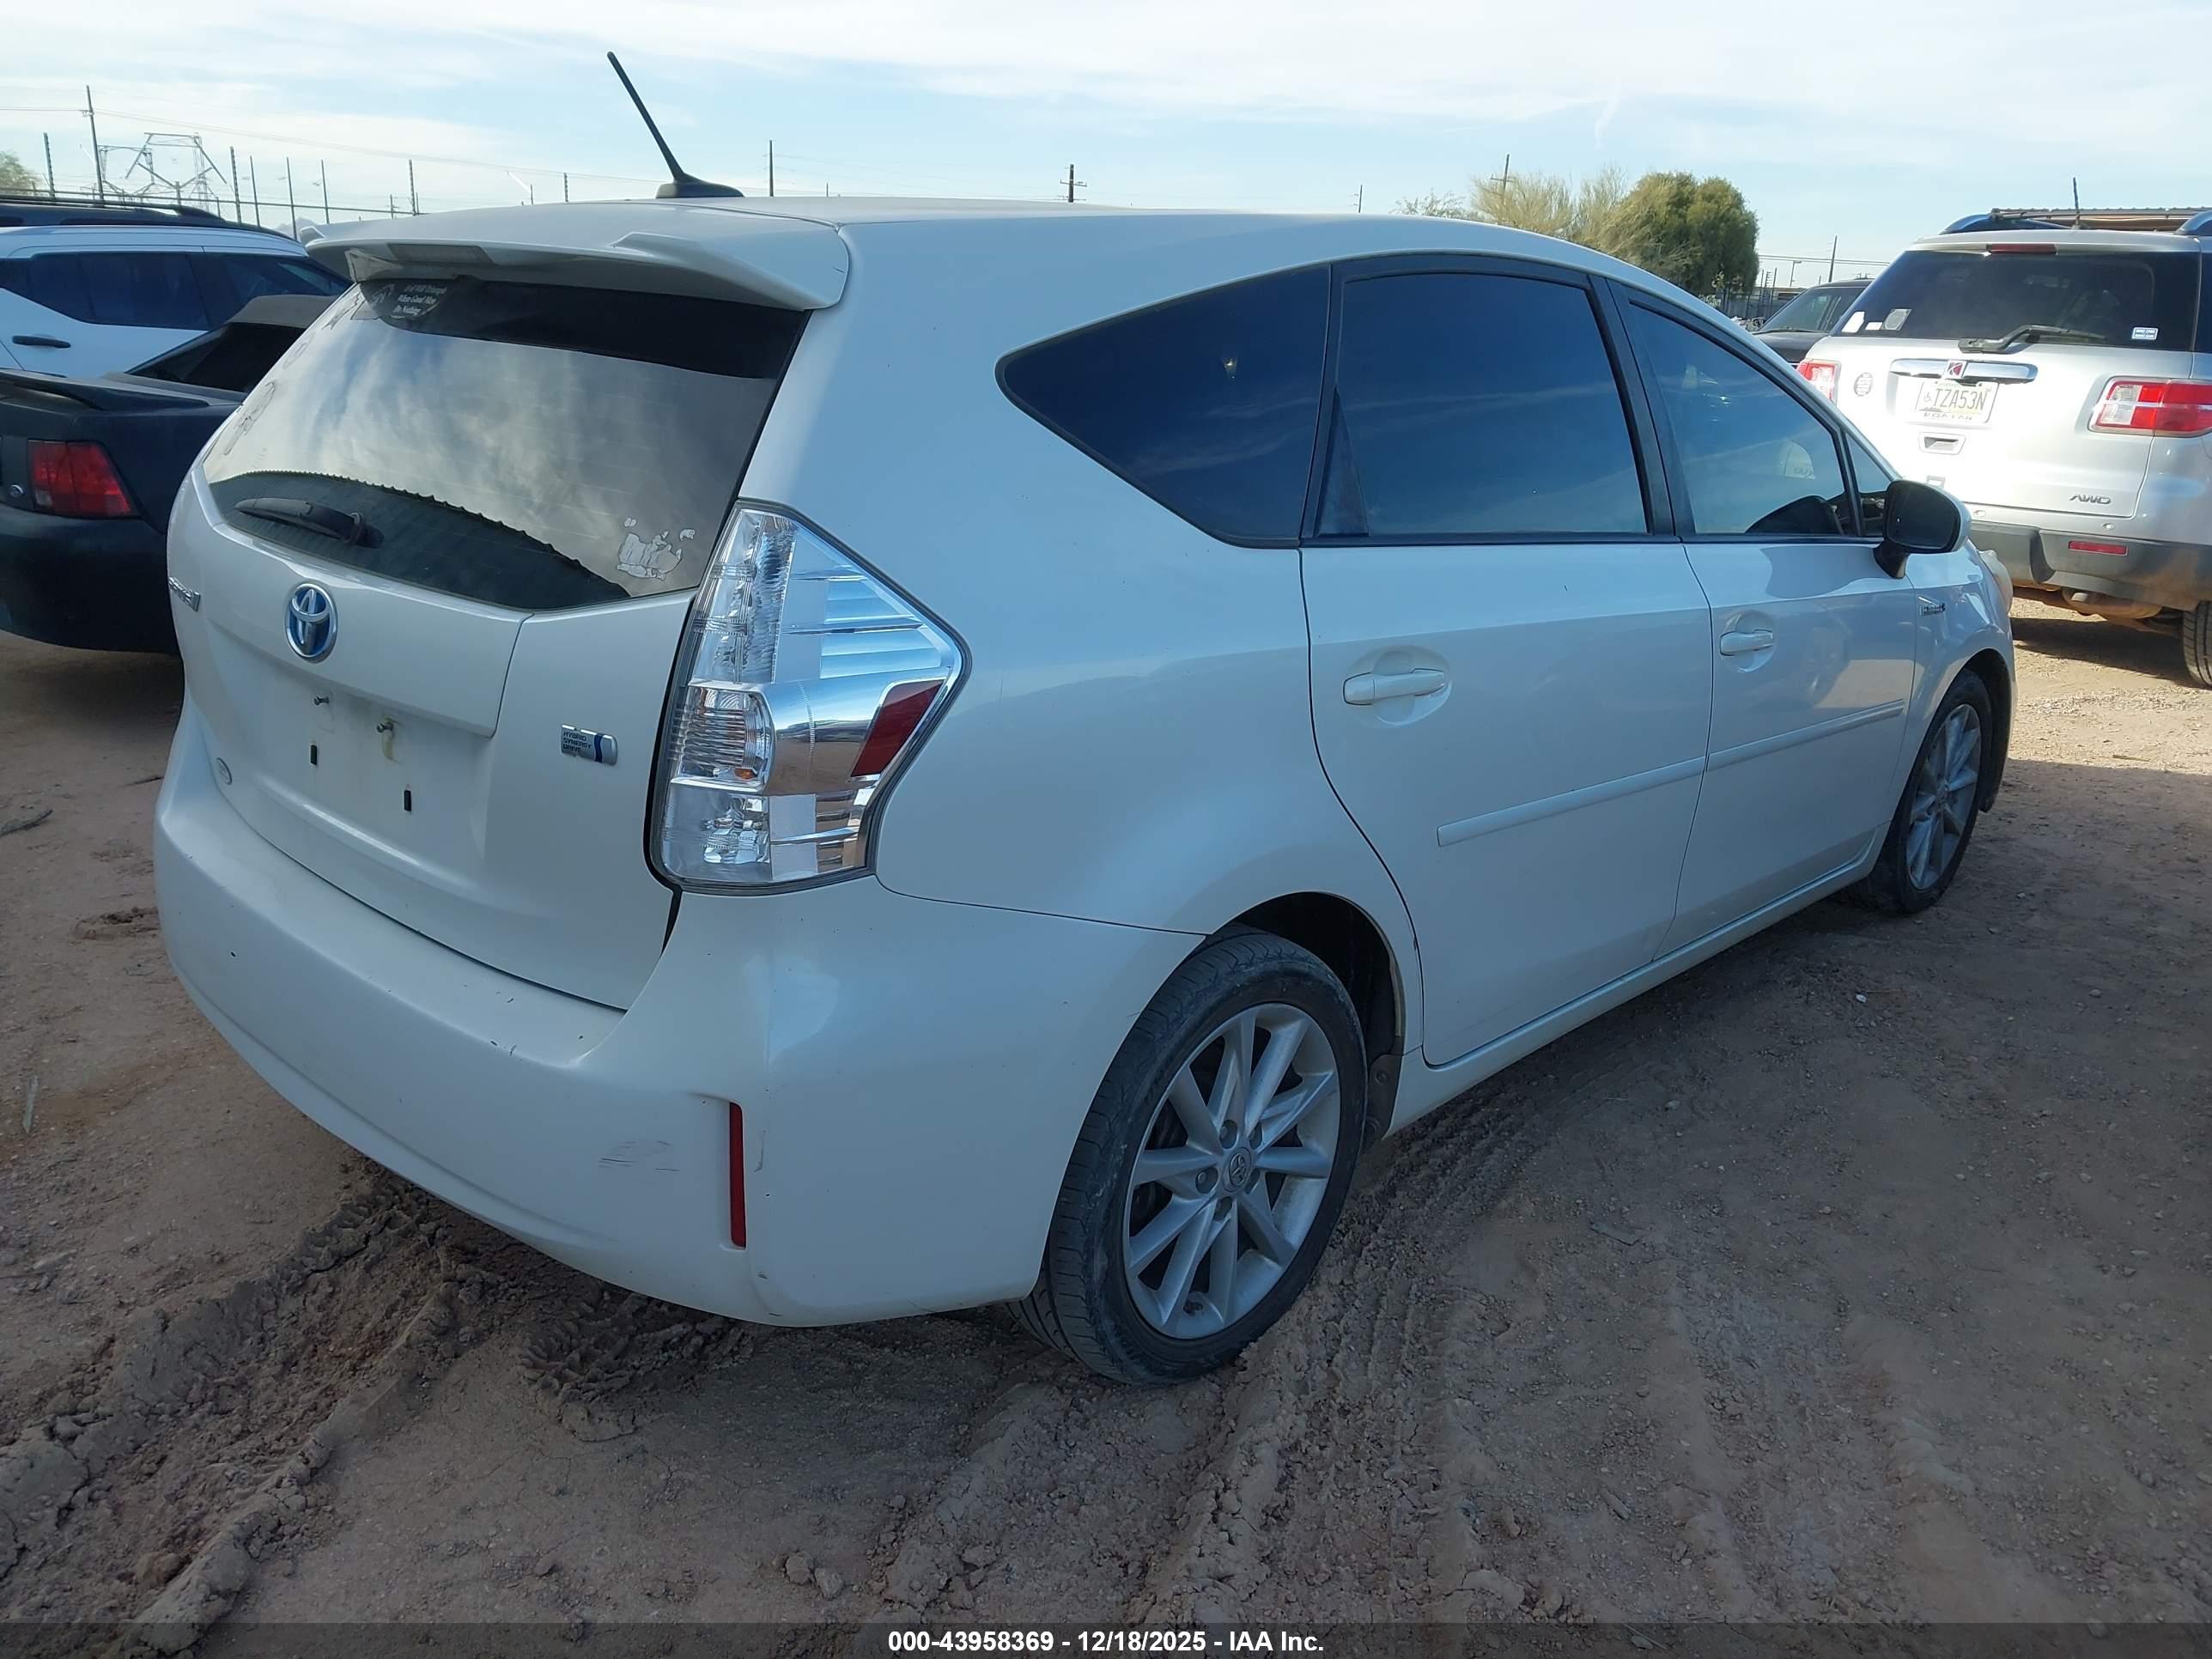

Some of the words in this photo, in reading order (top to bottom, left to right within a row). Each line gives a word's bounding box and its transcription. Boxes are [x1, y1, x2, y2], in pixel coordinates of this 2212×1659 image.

[1933, 388, 1987, 410] TZA53N
[2069, 494, 2112, 504] AWD
[563, 732, 586, 741] HYBRID
